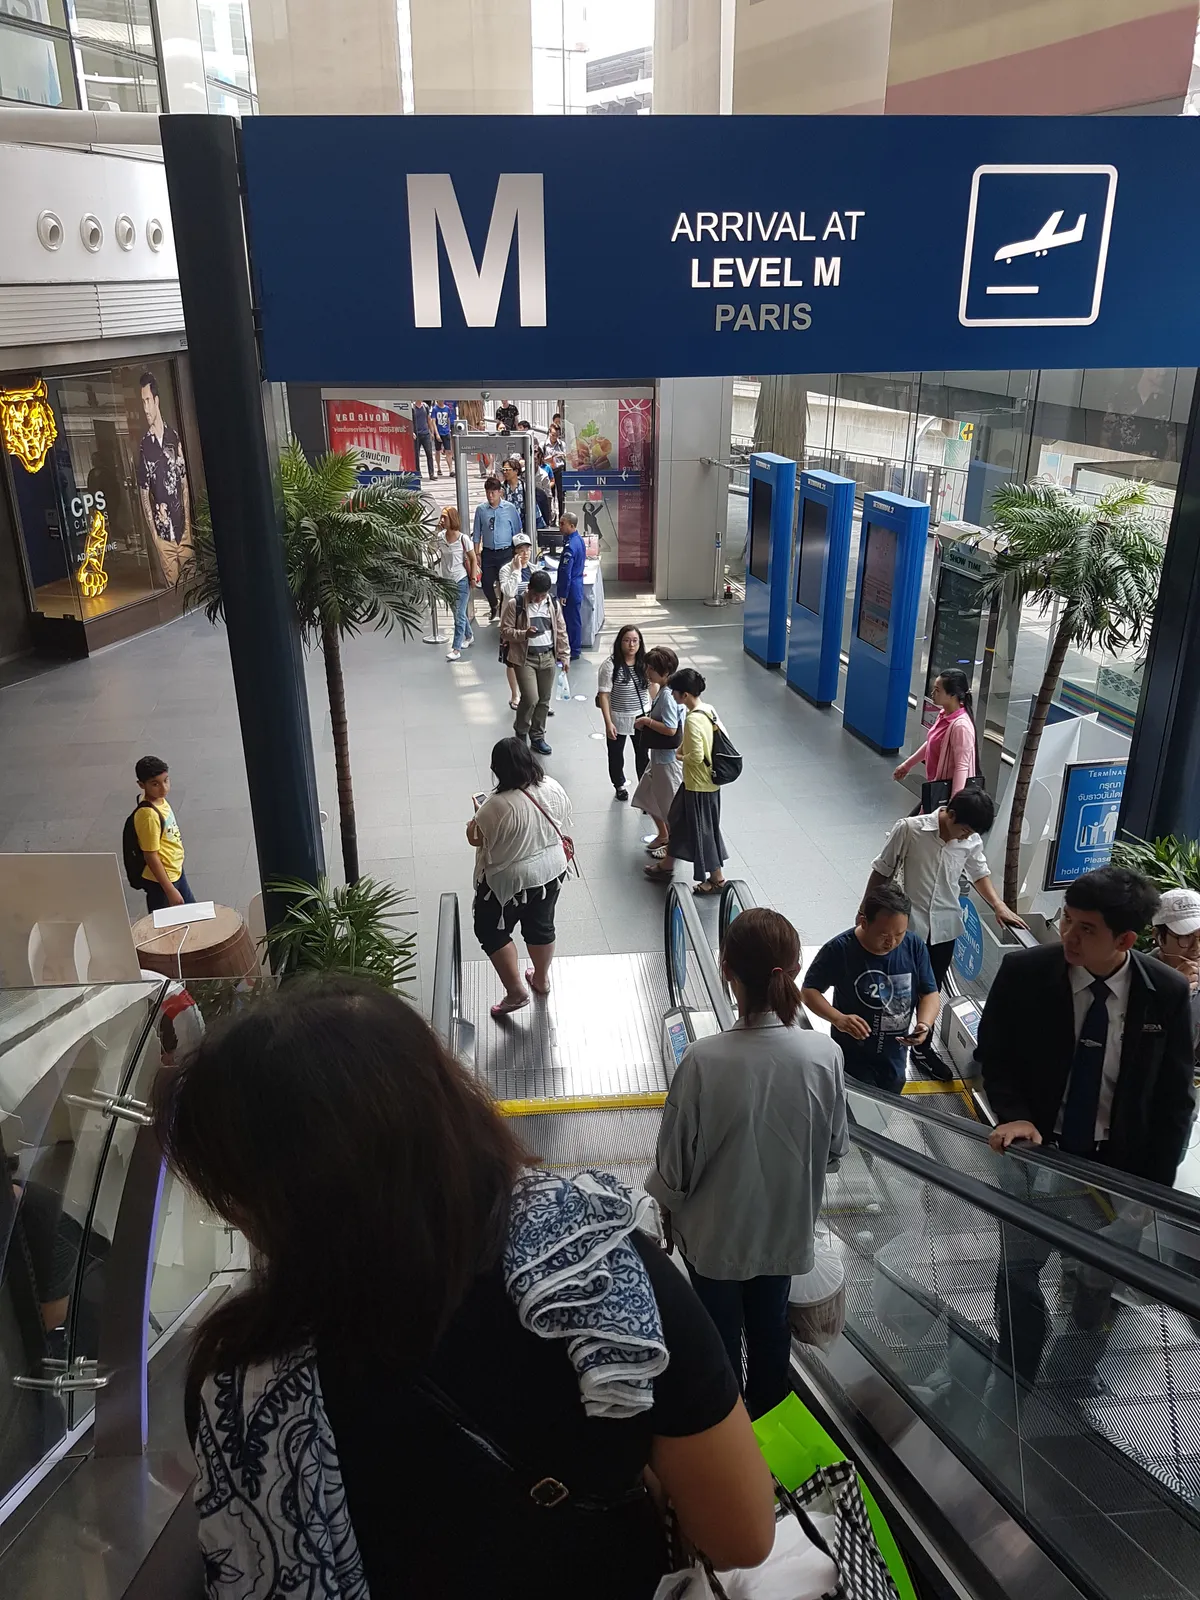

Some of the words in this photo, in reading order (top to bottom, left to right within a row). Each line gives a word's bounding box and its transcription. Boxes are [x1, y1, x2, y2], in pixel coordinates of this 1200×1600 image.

[671, 211, 816, 242] ARRIVAL
[823, 211, 866, 241] AT
[406, 173, 547, 328] M
[690, 257, 803, 289] LEVEL
[813, 256, 842, 288] M
[714, 302, 813, 332] PARIS
[596, 476, 607, 485] IN
[71, 490, 107, 518] CPS
[74, 511, 109, 529] CHAS
[949, 553, 967, 566] SHOW
[967, 560, 982, 572] TIME
[1061, 867, 1079, 875] hold
